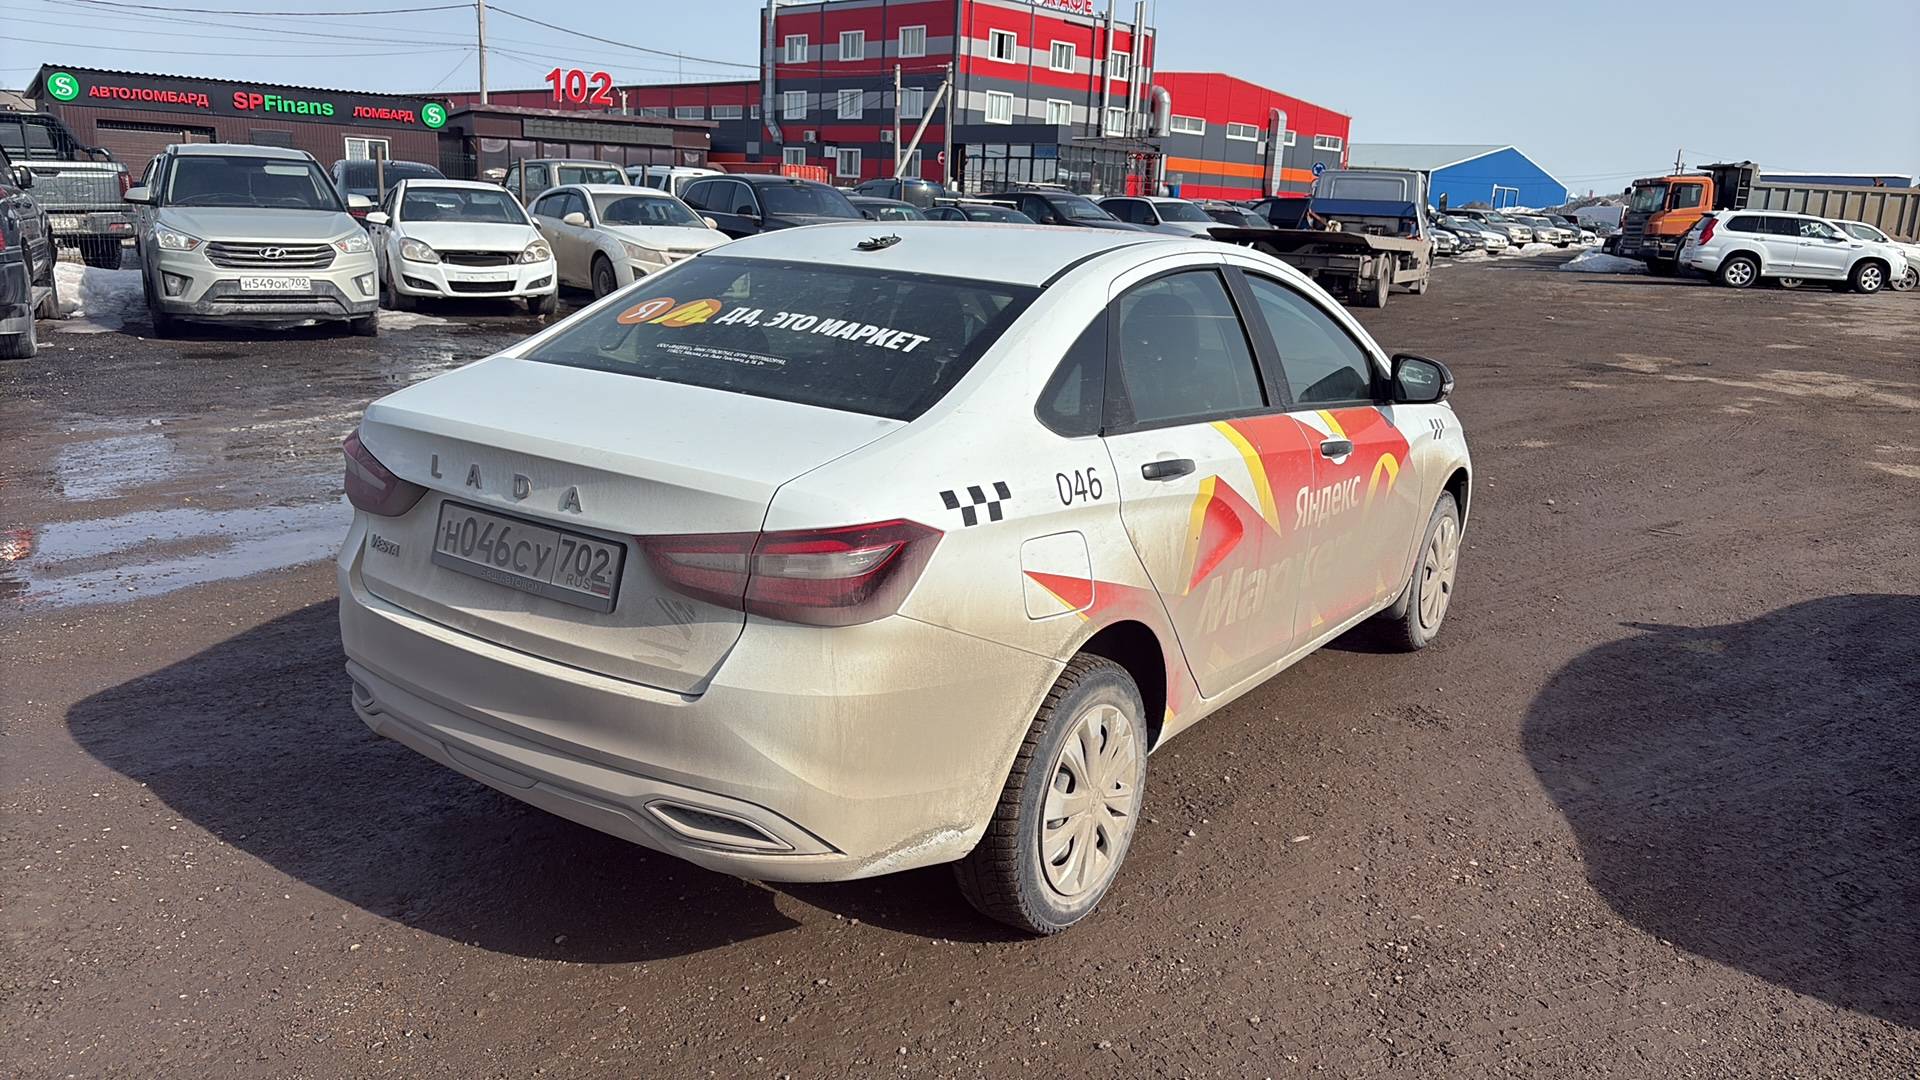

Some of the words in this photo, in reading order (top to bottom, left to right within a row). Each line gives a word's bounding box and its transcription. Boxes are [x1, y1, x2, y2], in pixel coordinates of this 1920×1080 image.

[89, 85, 209, 108] АВТОЛОМБАРД
[233, 91, 334, 116] SPFinans
[545, 67, 613, 106] 102
[353, 106, 414, 123] ЛОМБАРД
[713, 307, 764, 328] ДА,
[762, 311, 818, 332] ЭТО
[810, 318, 931, 353] МАРКЕТ
[431, 454, 583, 514] LADA
[1056, 466, 1103, 506] 046
[1294, 475, 1361, 531] Яндекс
[559, 538, 611, 584] 702
[565, 573, 592, 590] RUS
